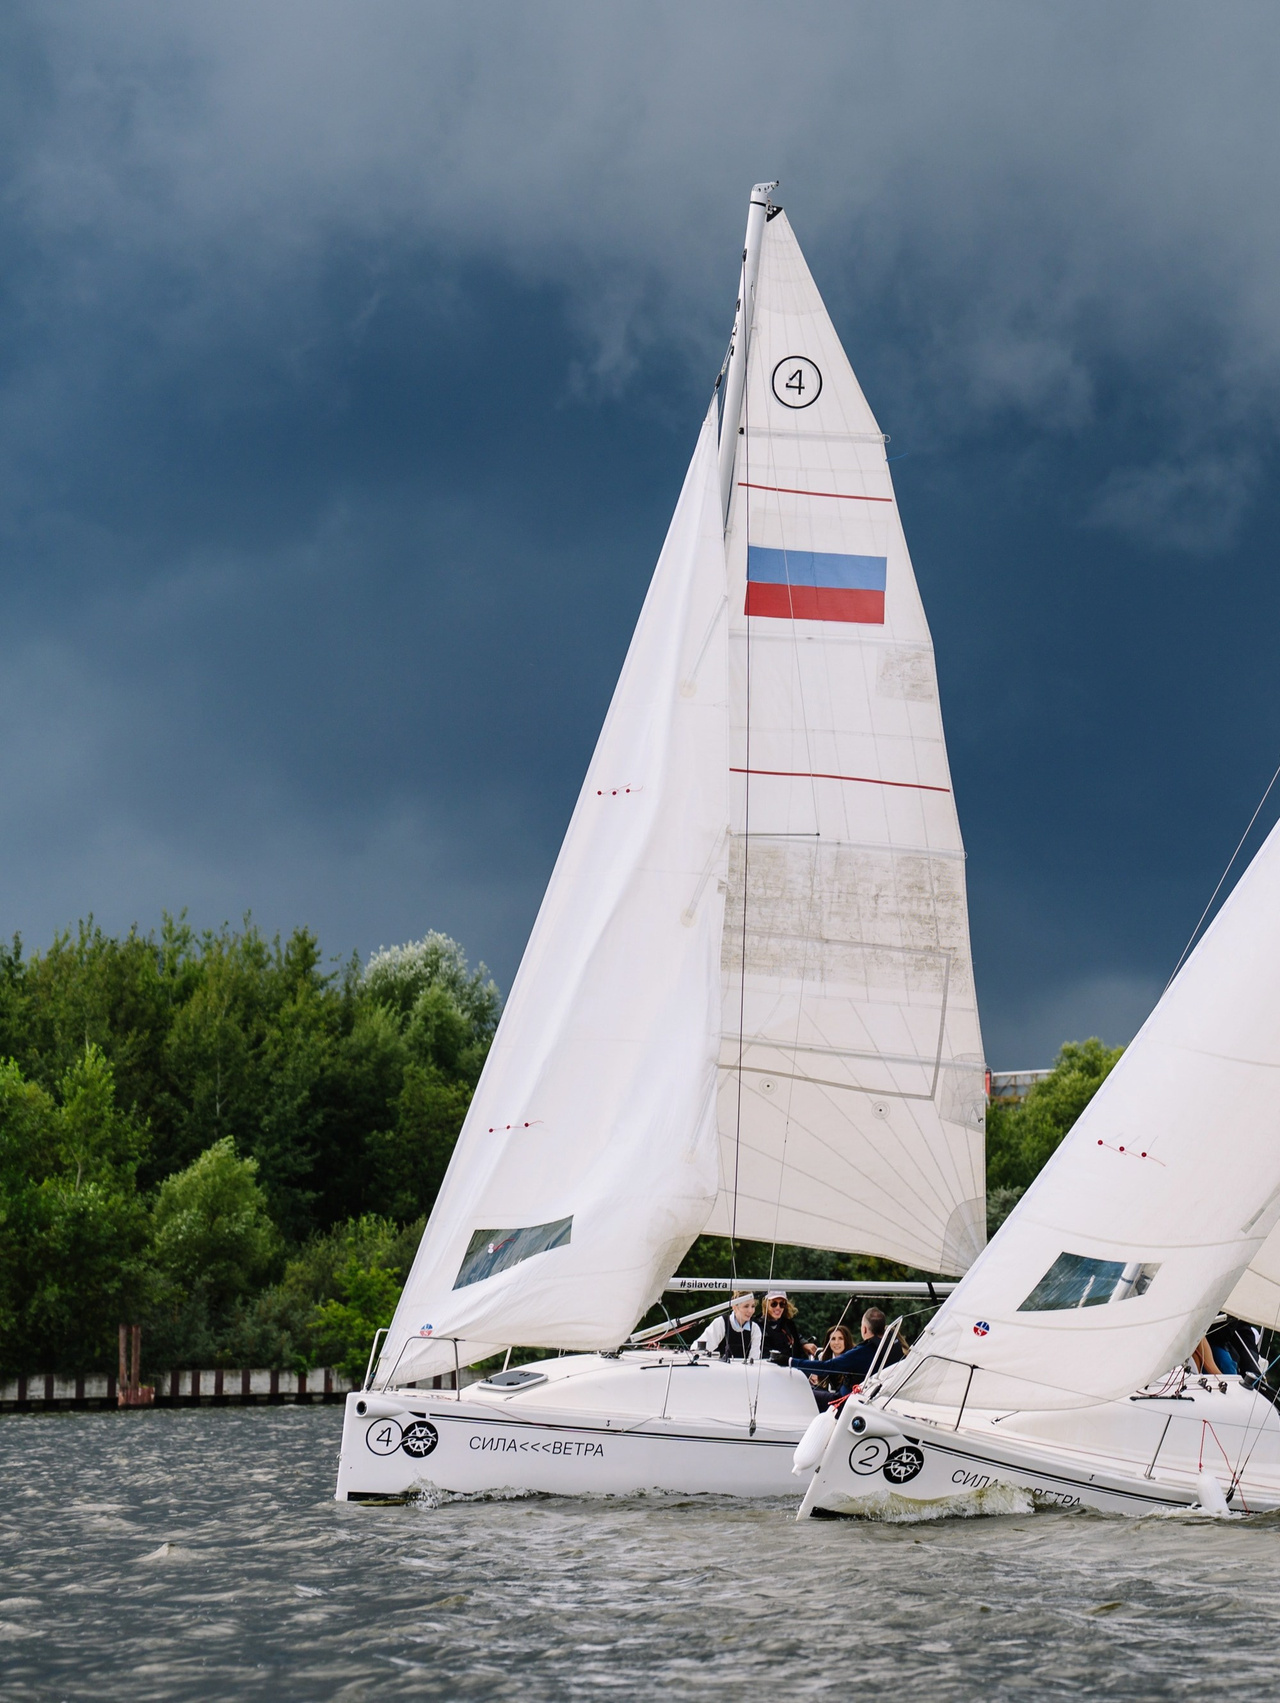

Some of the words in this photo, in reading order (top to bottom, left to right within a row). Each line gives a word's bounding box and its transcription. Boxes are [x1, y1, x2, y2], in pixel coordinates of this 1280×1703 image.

[786, 369, 805, 396] 4
[680, 1280, 728, 1289] #silavetra
[376, 1427, 393, 1448] 4
[858, 1445, 880, 1467] 2
